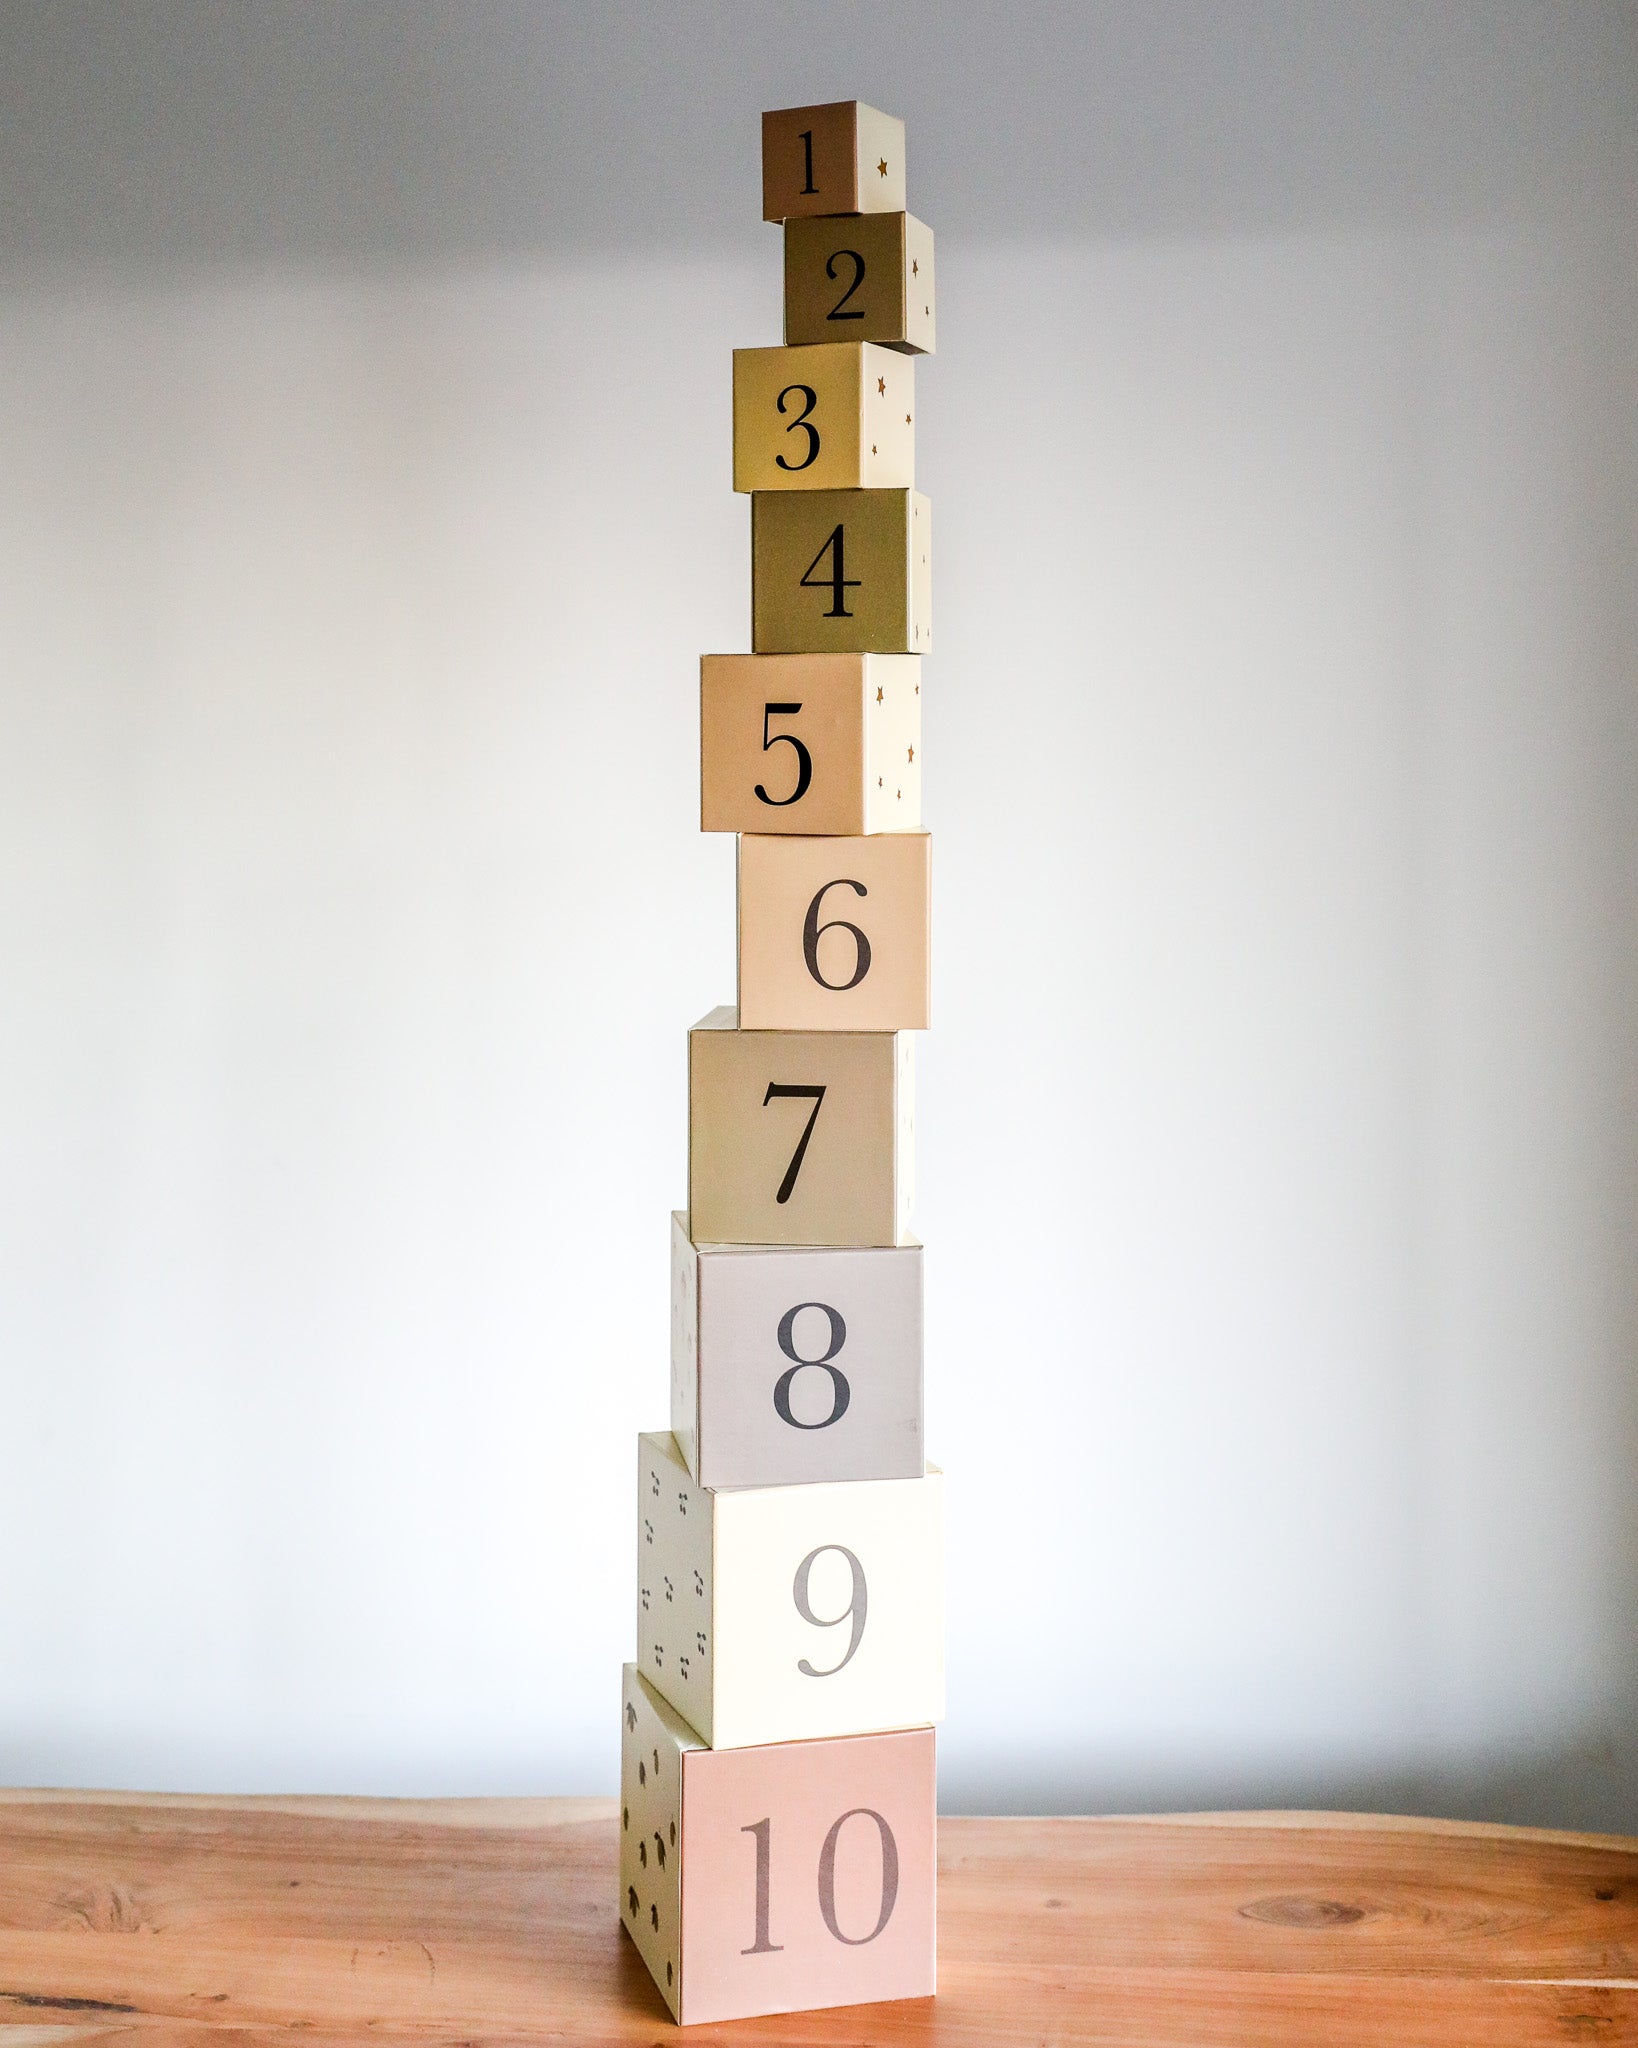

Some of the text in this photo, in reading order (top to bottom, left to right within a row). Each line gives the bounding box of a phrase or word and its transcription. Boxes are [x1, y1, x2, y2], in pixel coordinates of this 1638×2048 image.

[798, 130, 820, 194] 1
[825, 249, 866, 321] 2
[775, 384, 821, 471] 3
[799, 523, 862, 618] 4
[754, 702, 813, 806] 5
[802, 878, 872, 991] 6
[762, 1081, 827, 1205] 7
[773, 1302, 851, 1430] 8
[792, 1544, 868, 1678] 9
[740, 1807, 899, 1956] 10
